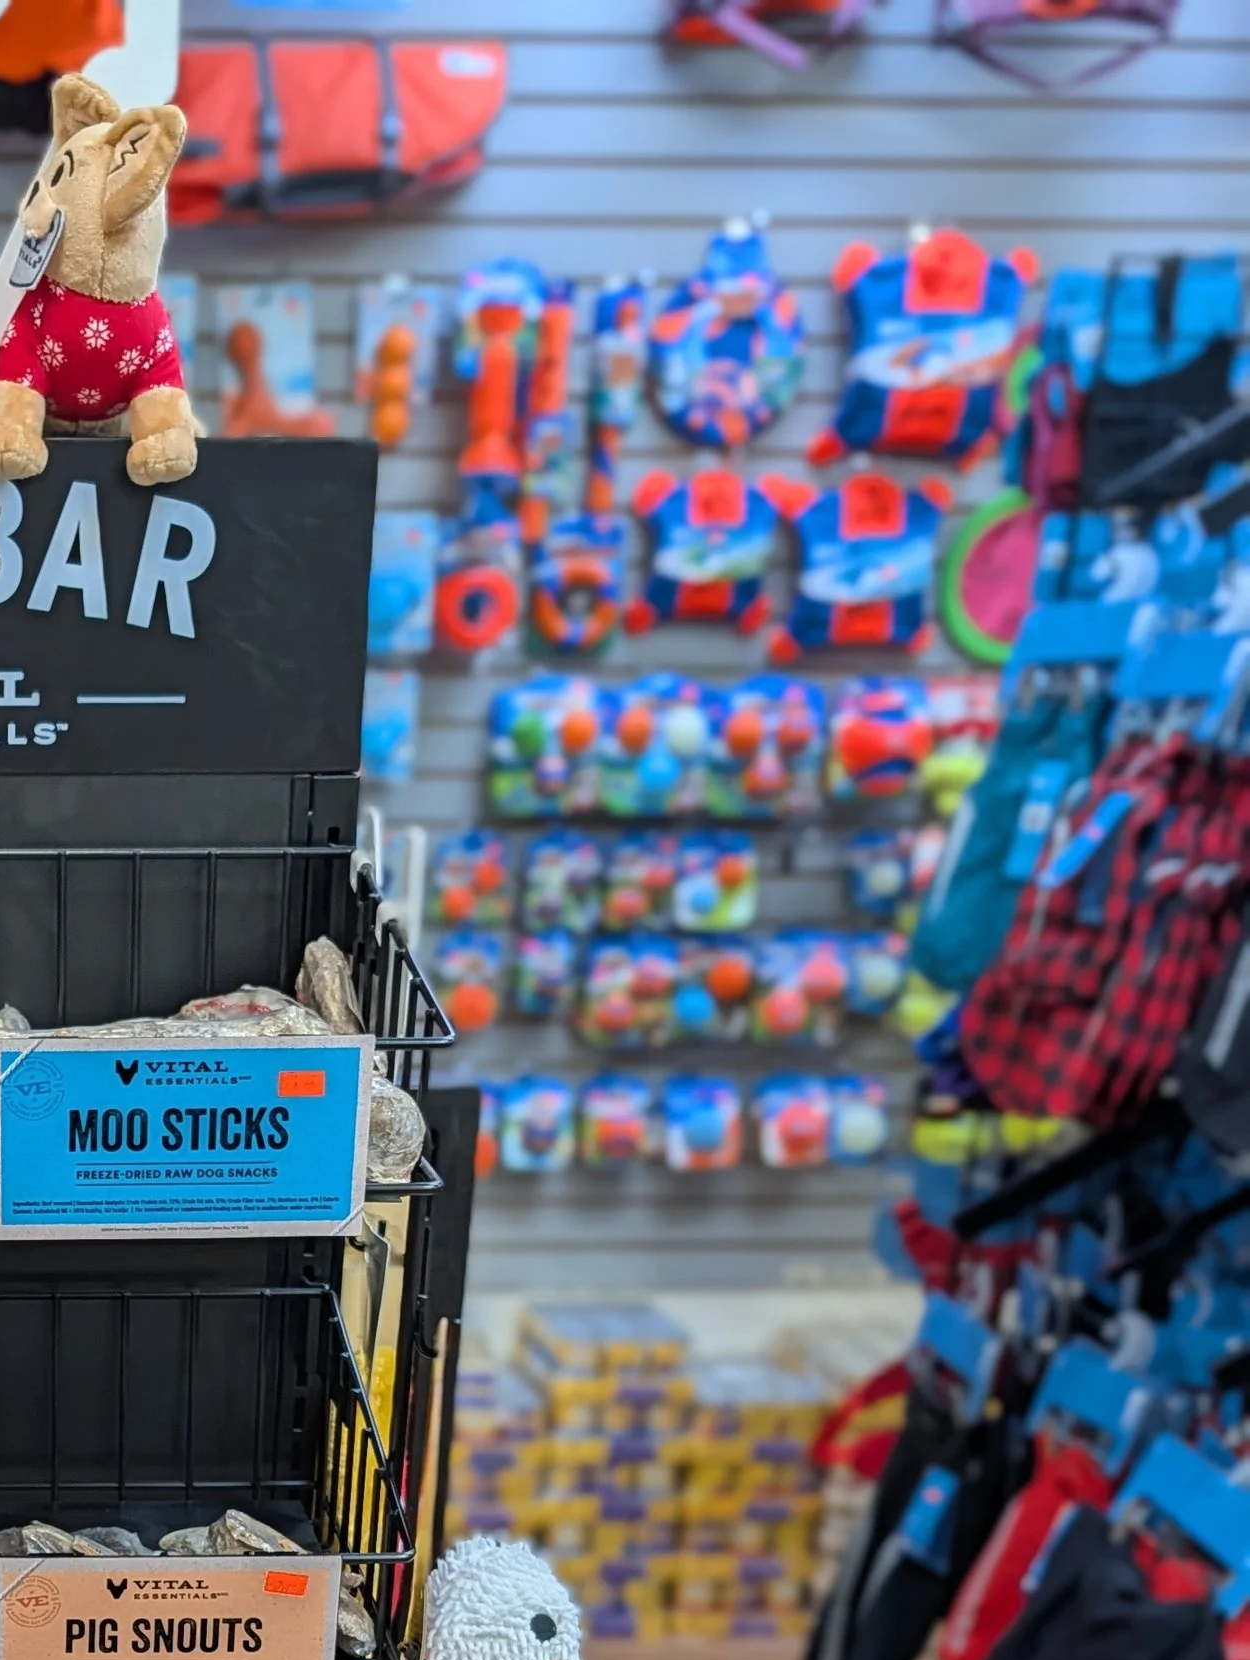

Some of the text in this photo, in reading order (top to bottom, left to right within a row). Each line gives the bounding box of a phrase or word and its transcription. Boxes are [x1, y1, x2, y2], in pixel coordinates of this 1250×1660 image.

[144, 1061, 229, 1073] VITAL
[68, 1106, 290, 1153] MOO STICKS
[75, 1167, 278, 1180] FREEZE-DRIED RAW DOG SNACKS
[133, 1580, 209, 1590] VITAL
[65, 1617, 263, 1653] PIG SNOUTS
